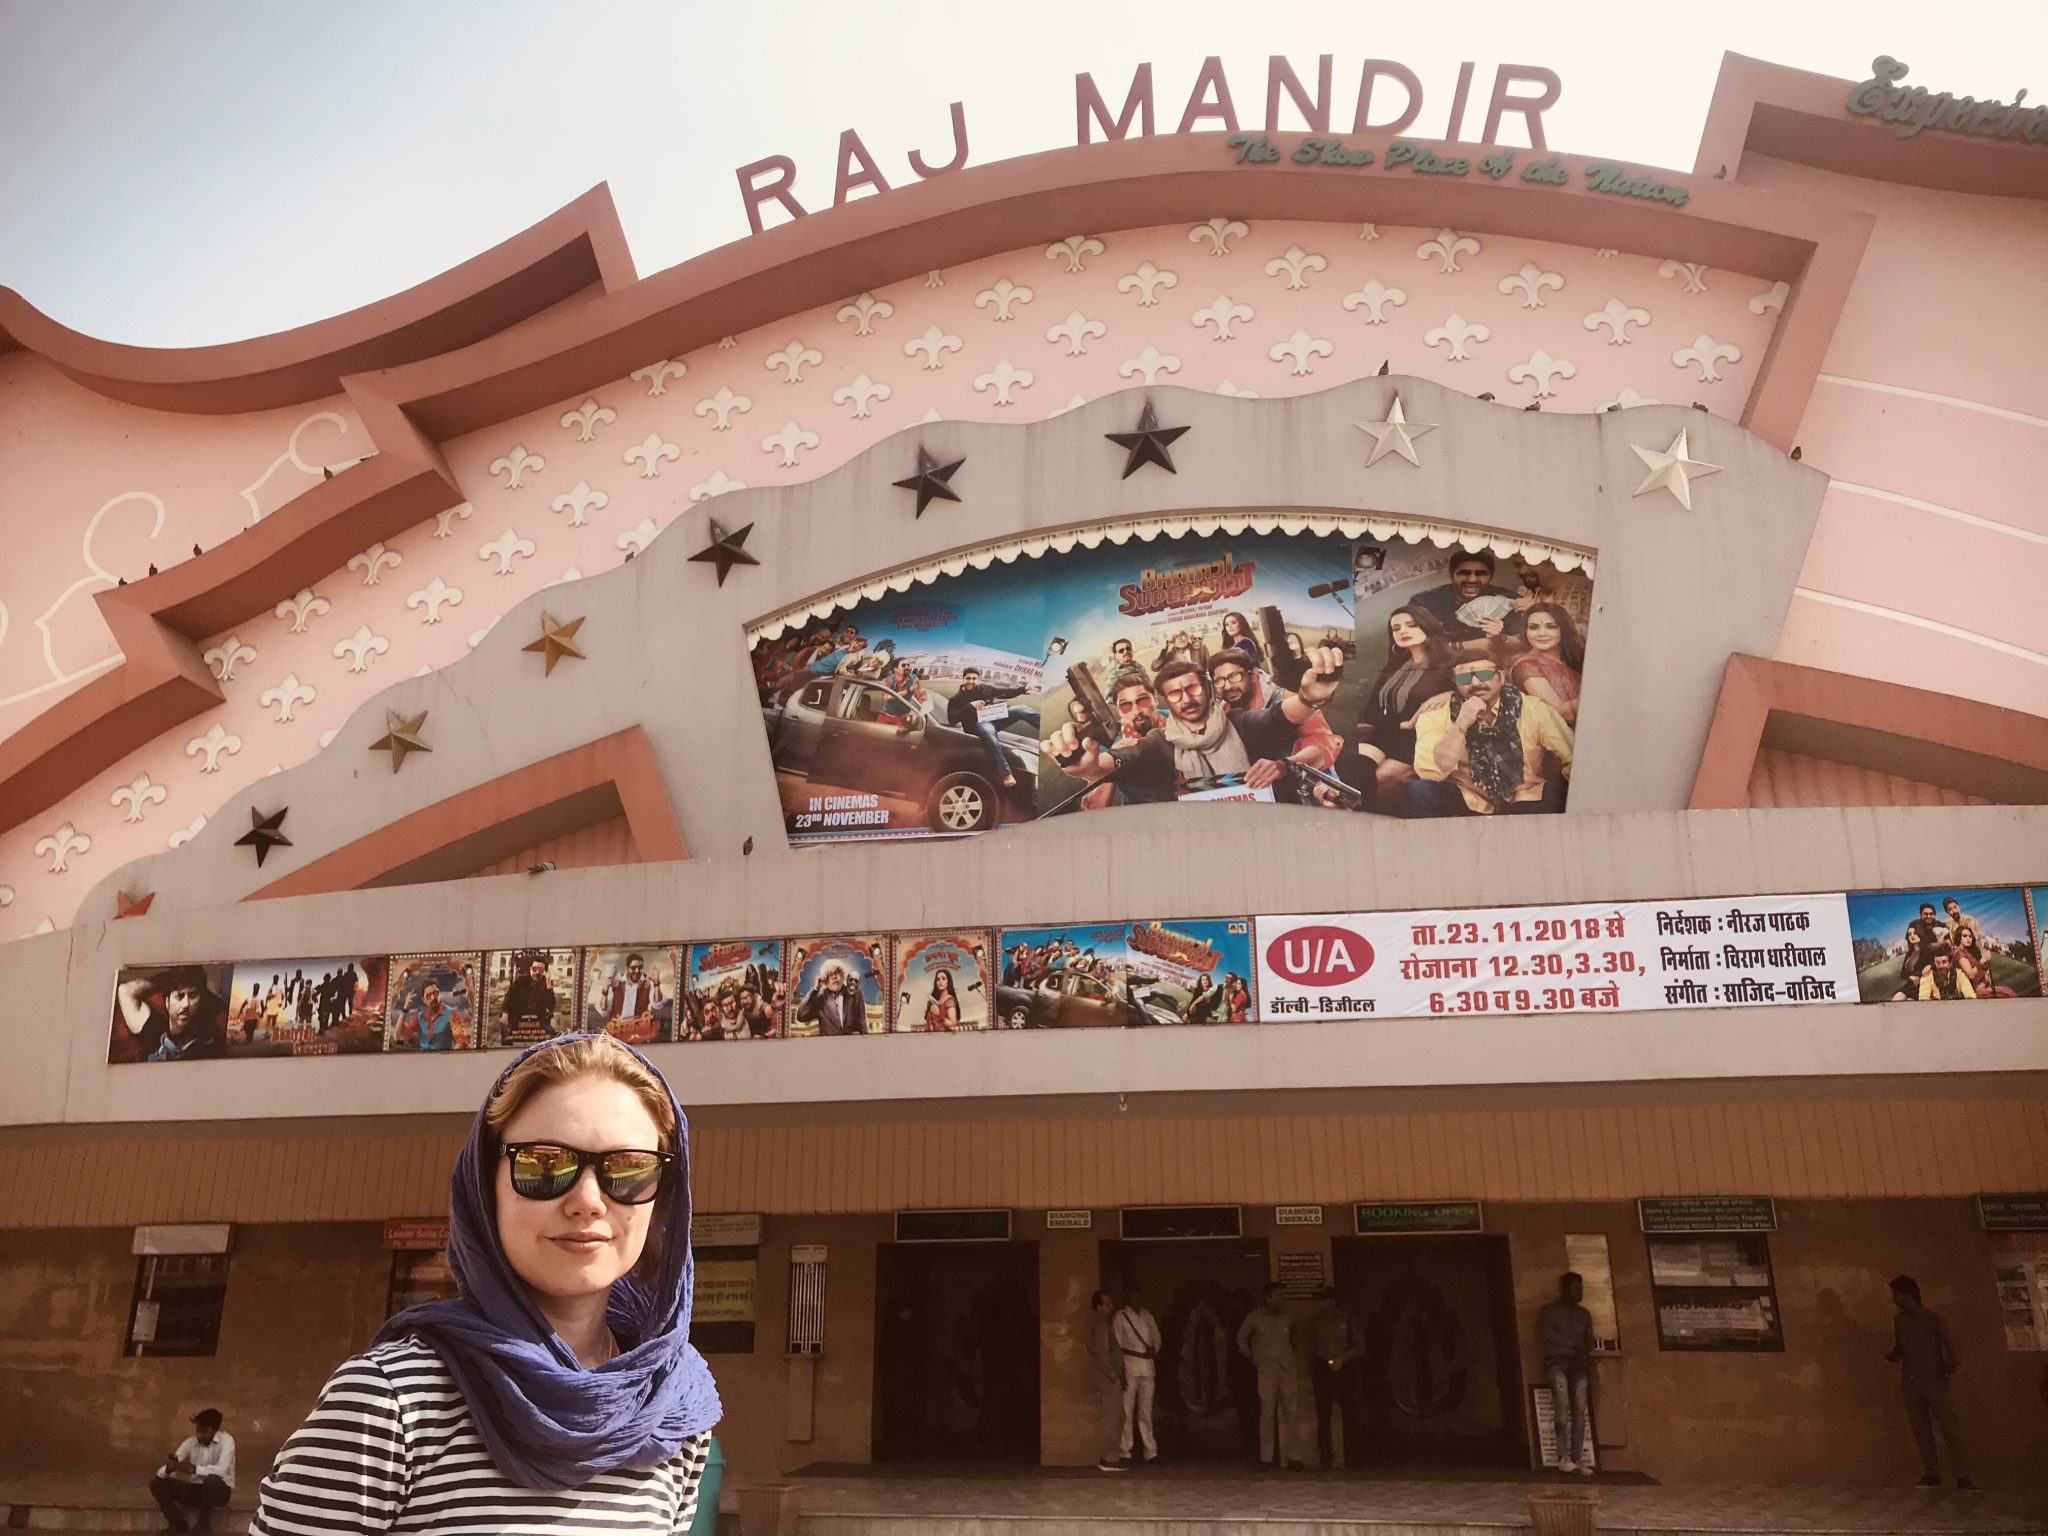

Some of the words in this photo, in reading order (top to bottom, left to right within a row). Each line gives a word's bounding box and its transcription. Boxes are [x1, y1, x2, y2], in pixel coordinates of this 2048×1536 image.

[735, 101, 970, 236] RAJ
[1075, 53, 1562, 150] MANDIR
[1227, 134, 1281, 165] The
[1291, 136, 1375, 169] Show
[1384, 140, 1470, 176] Place
[1479, 147, 1513, 180] of
[1520, 156, 1569, 186] the
[1585, 163, 1689, 209] Nation
[809, 797, 822, 811] IN
[824, 794, 878, 811] CINEMAS
[795, 813, 822, 828] 23RD
[823, 810, 890, 827] NOVEMBER
[1605, 911, 1625, 938] से
[1656, 910, 1712, 935] निर्देशक
[1726, 909, 1766, 933] नीरज
[1768, 911, 1810, 932] पाठक
[1283, 938, 1356, 974] U/A
[1400, 953, 1477, 980] रोजाना
[1660, 945, 1710, 971] निर्माता
[1723, 944, 1766, 969] चिराग
[1767, 942, 1826, 967] धारीवाल
[1430, 990, 1488, 1013] 6.30
[1493, 990, 1510, 1011] व
[1515, 988, 1575, 1011] 9.30
[1580, 980, 1620, 1008] बजे
[1664, 979, 1707, 1004] संगीत
[1361, 1206, 1429, 1218] BOOKING
[1434, 1205, 1475, 1217] OPEN
